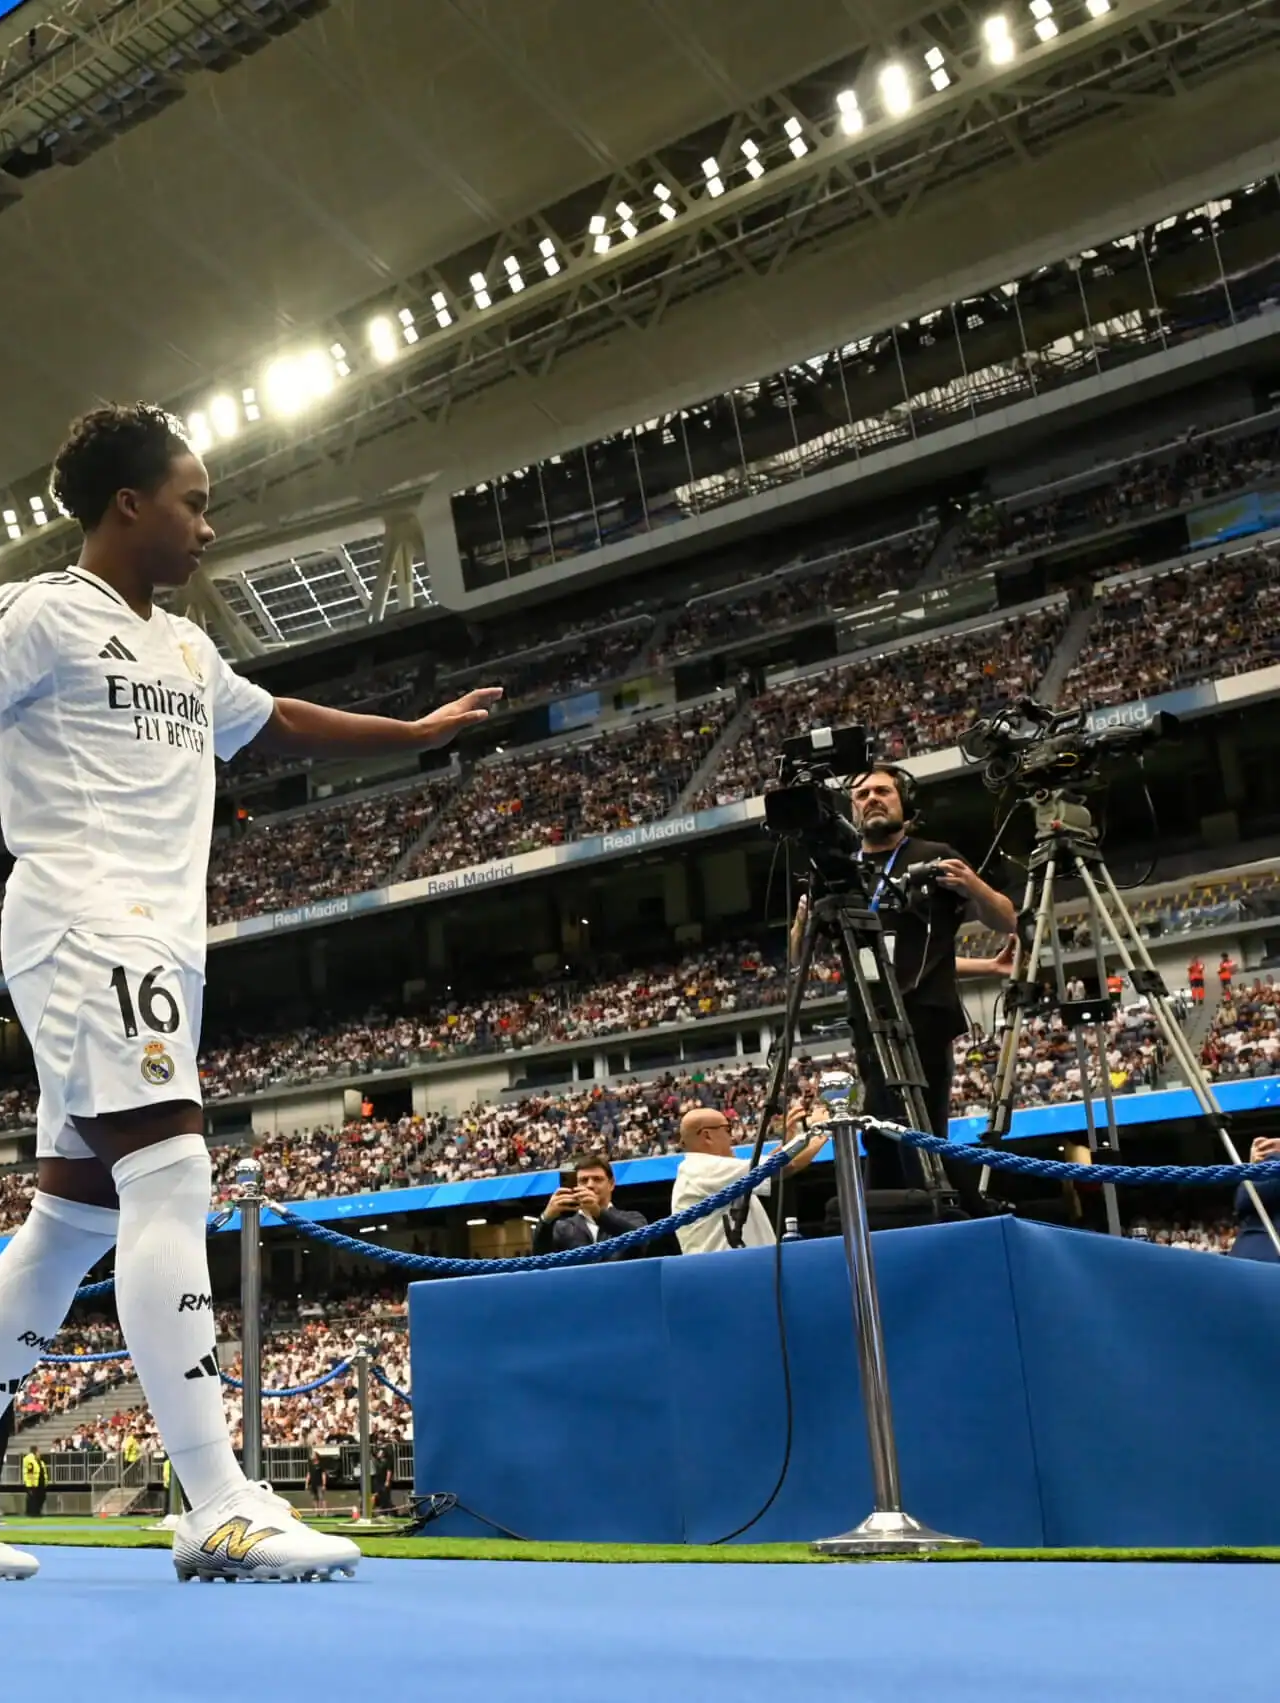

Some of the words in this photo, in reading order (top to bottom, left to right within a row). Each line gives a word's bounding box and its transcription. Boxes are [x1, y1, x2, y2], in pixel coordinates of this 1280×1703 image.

[105, 675, 209, 728] Emirates
[134, 716, 160, 741] FLY
[166, 721, 204, 758] BETTER
[603, 834, 636, 852] Real
[641, 816, 696, 842] Madrid
[428, 875, 459, 895] Real
[463, 864, 514, 888] Madrid
[274, 909, 301, 926] Real
[305, 898, 349, 920] Madrid
[109, 965, 180, 1038] 16
